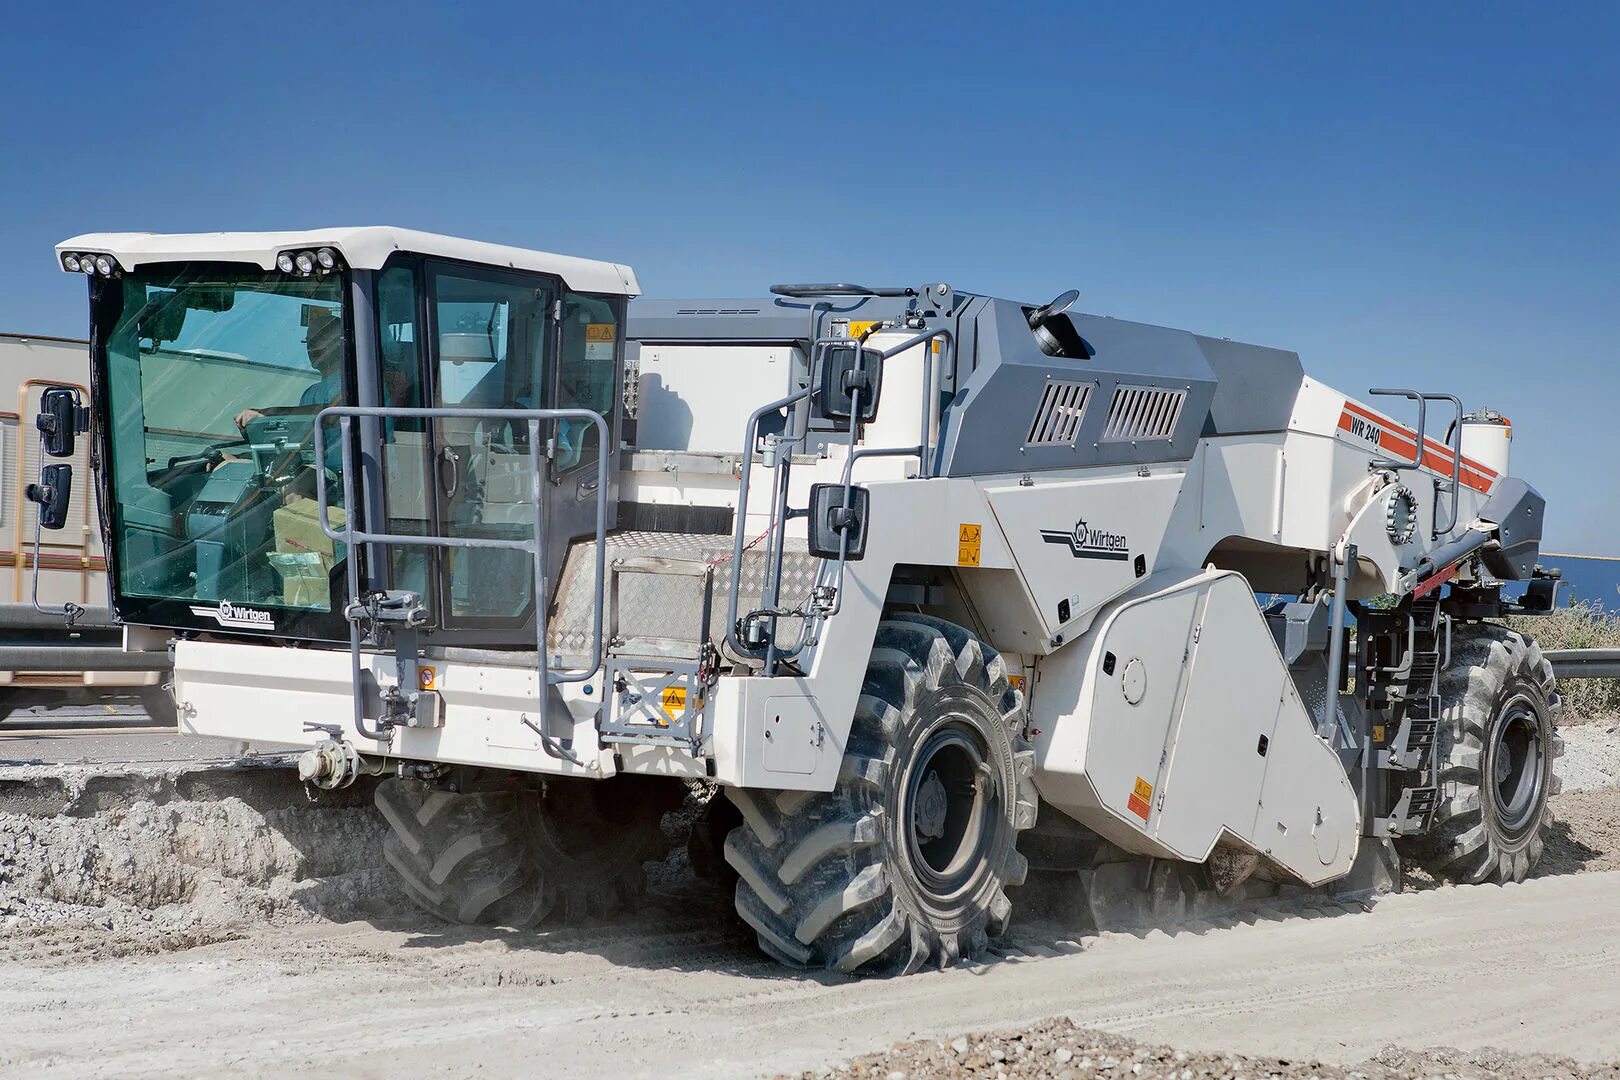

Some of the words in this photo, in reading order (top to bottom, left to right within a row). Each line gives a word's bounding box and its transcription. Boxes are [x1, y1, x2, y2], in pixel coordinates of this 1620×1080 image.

[1352, 416, 1365, 438] WR
[1365, 424, 1380, 445] 240
[1090, 529, 1126, 551] Wirtgen
[233, 606, 271, 622] Wirtgen
